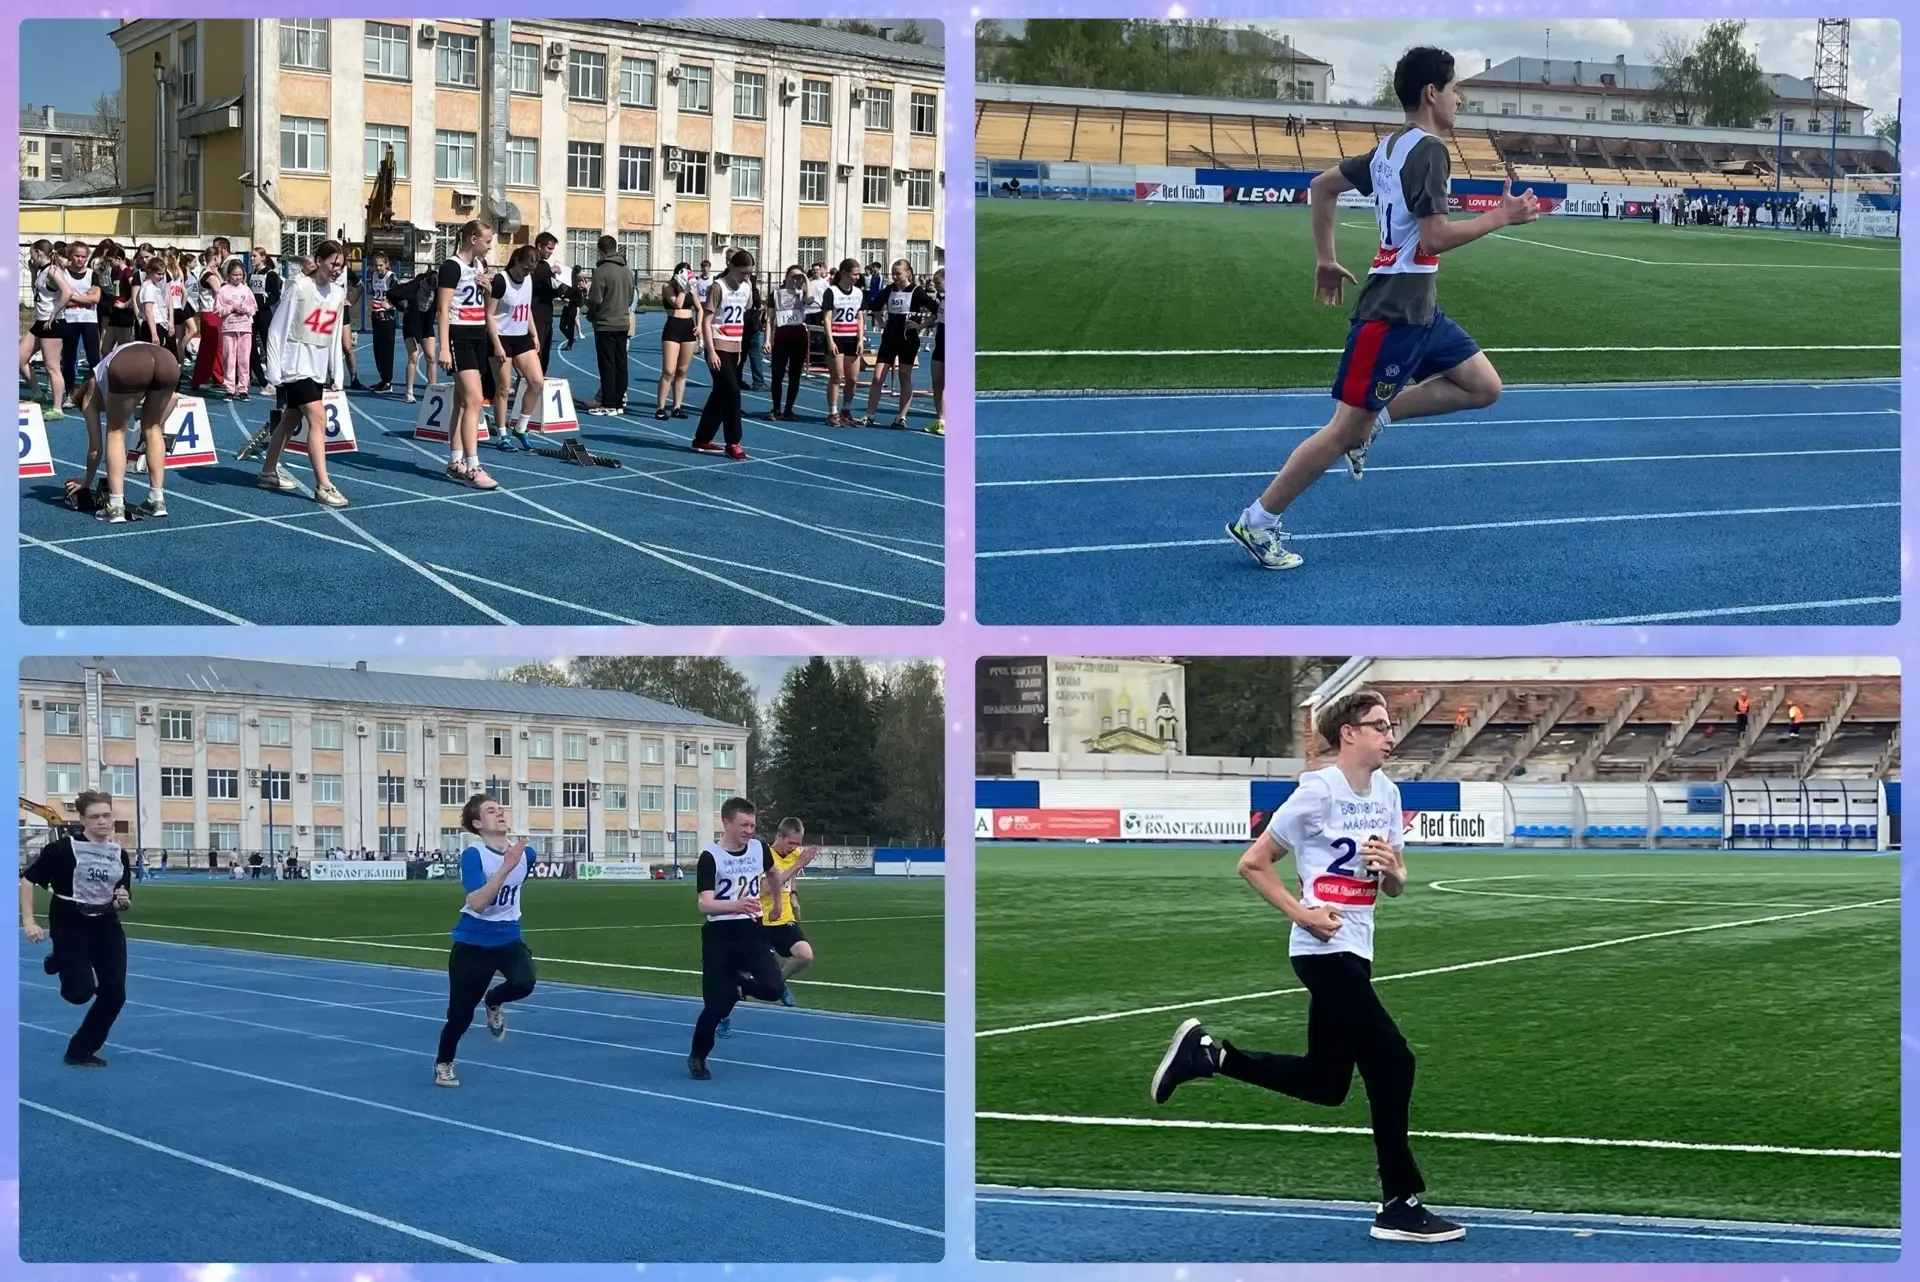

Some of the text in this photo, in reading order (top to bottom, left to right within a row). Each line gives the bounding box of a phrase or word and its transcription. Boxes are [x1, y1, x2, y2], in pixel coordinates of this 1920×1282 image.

[1162, 184, 1205, 199] Red finch
[1564, 200, 1600, 213] Red finch
[1641, 205, 1653, 213] VK
[303, 307, 338, 335] 42
[426, 395, 444, 427] 2
[552, 389, 563, 418] 1
[176, 411, 199, 449] 4
[323, 403, 340, 438] 3
[1145, 822, 1247, 834] ВОЛОГЖАНИН
[1420, 813, 1485, 840] Red finch
[425, 864, 445, 879] 15
